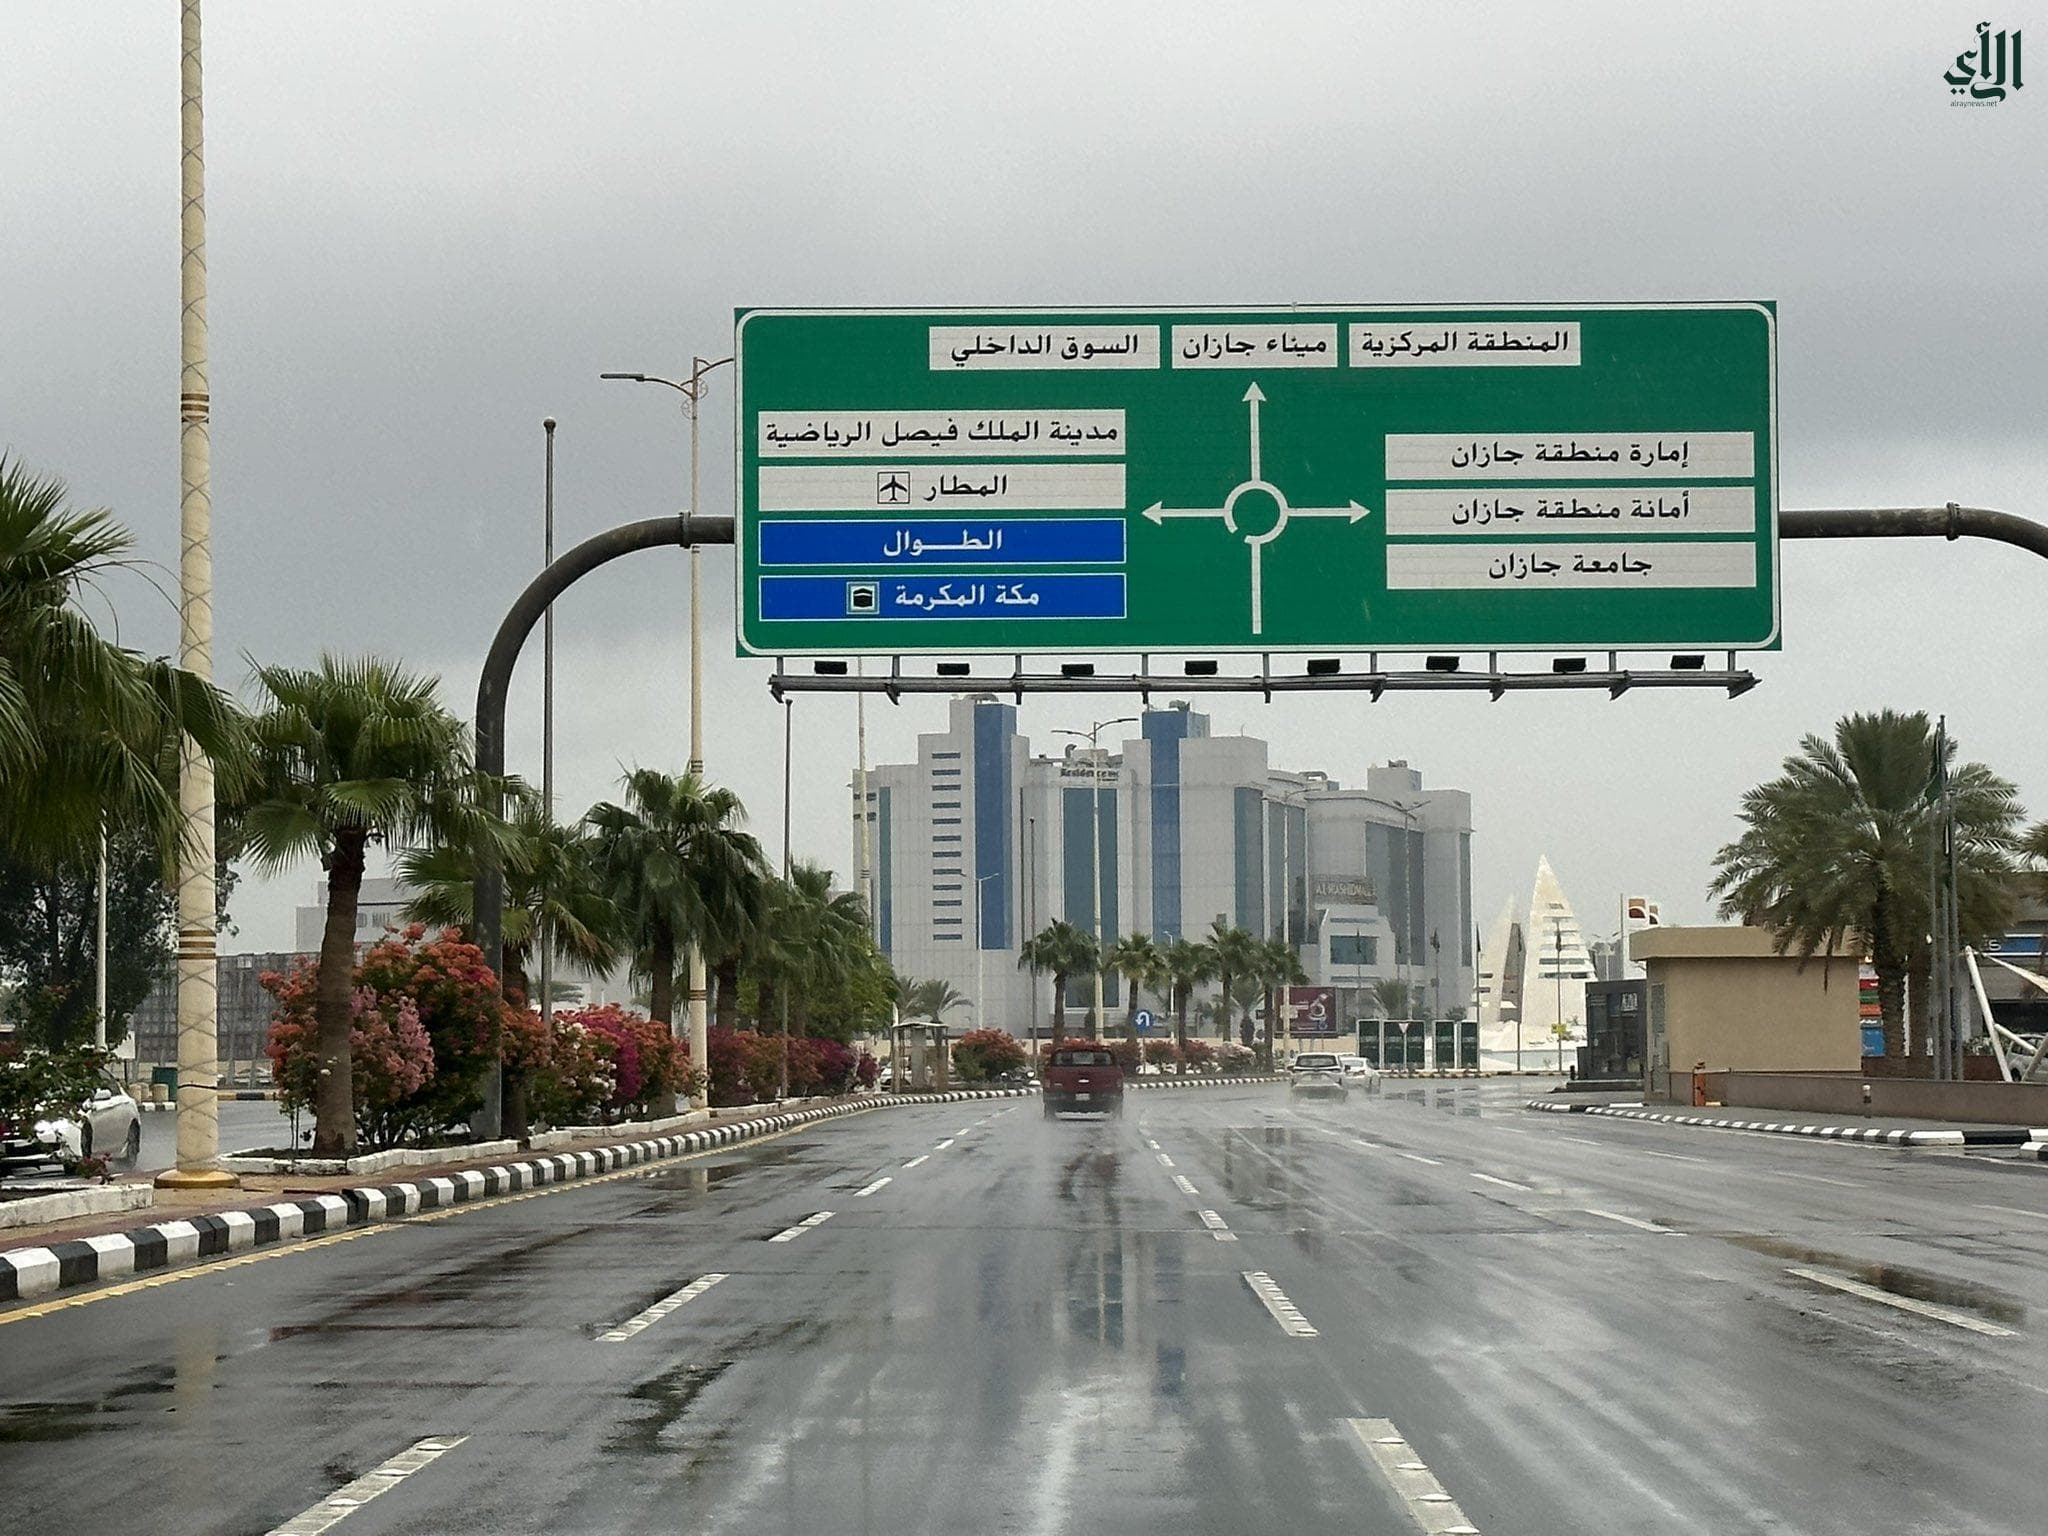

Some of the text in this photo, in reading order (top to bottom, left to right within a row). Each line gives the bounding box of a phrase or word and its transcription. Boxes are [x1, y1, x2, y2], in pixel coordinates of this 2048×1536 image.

[951, 334, 1138, 366] السوق الداخلي
[1182, 332, 1327, 360] ميناء جازان
[1361, 330, 1568, 358] المنطقة المركزية
[766, 417, 1118, 448] مدينة الملك فيصل الرياضية
[1451, 440, 1689, 468] إمارة منطقة جازان
[923, 474, 1007, 502] المطار
[1452, 490, 1689, 526] أمانة منطقة جازان
[883, 529, 1002, 557] الطوال
[1488, 551, 1653, 580] جامعة جازان
[895, 583, 1039, 611] مكة المكرمة
